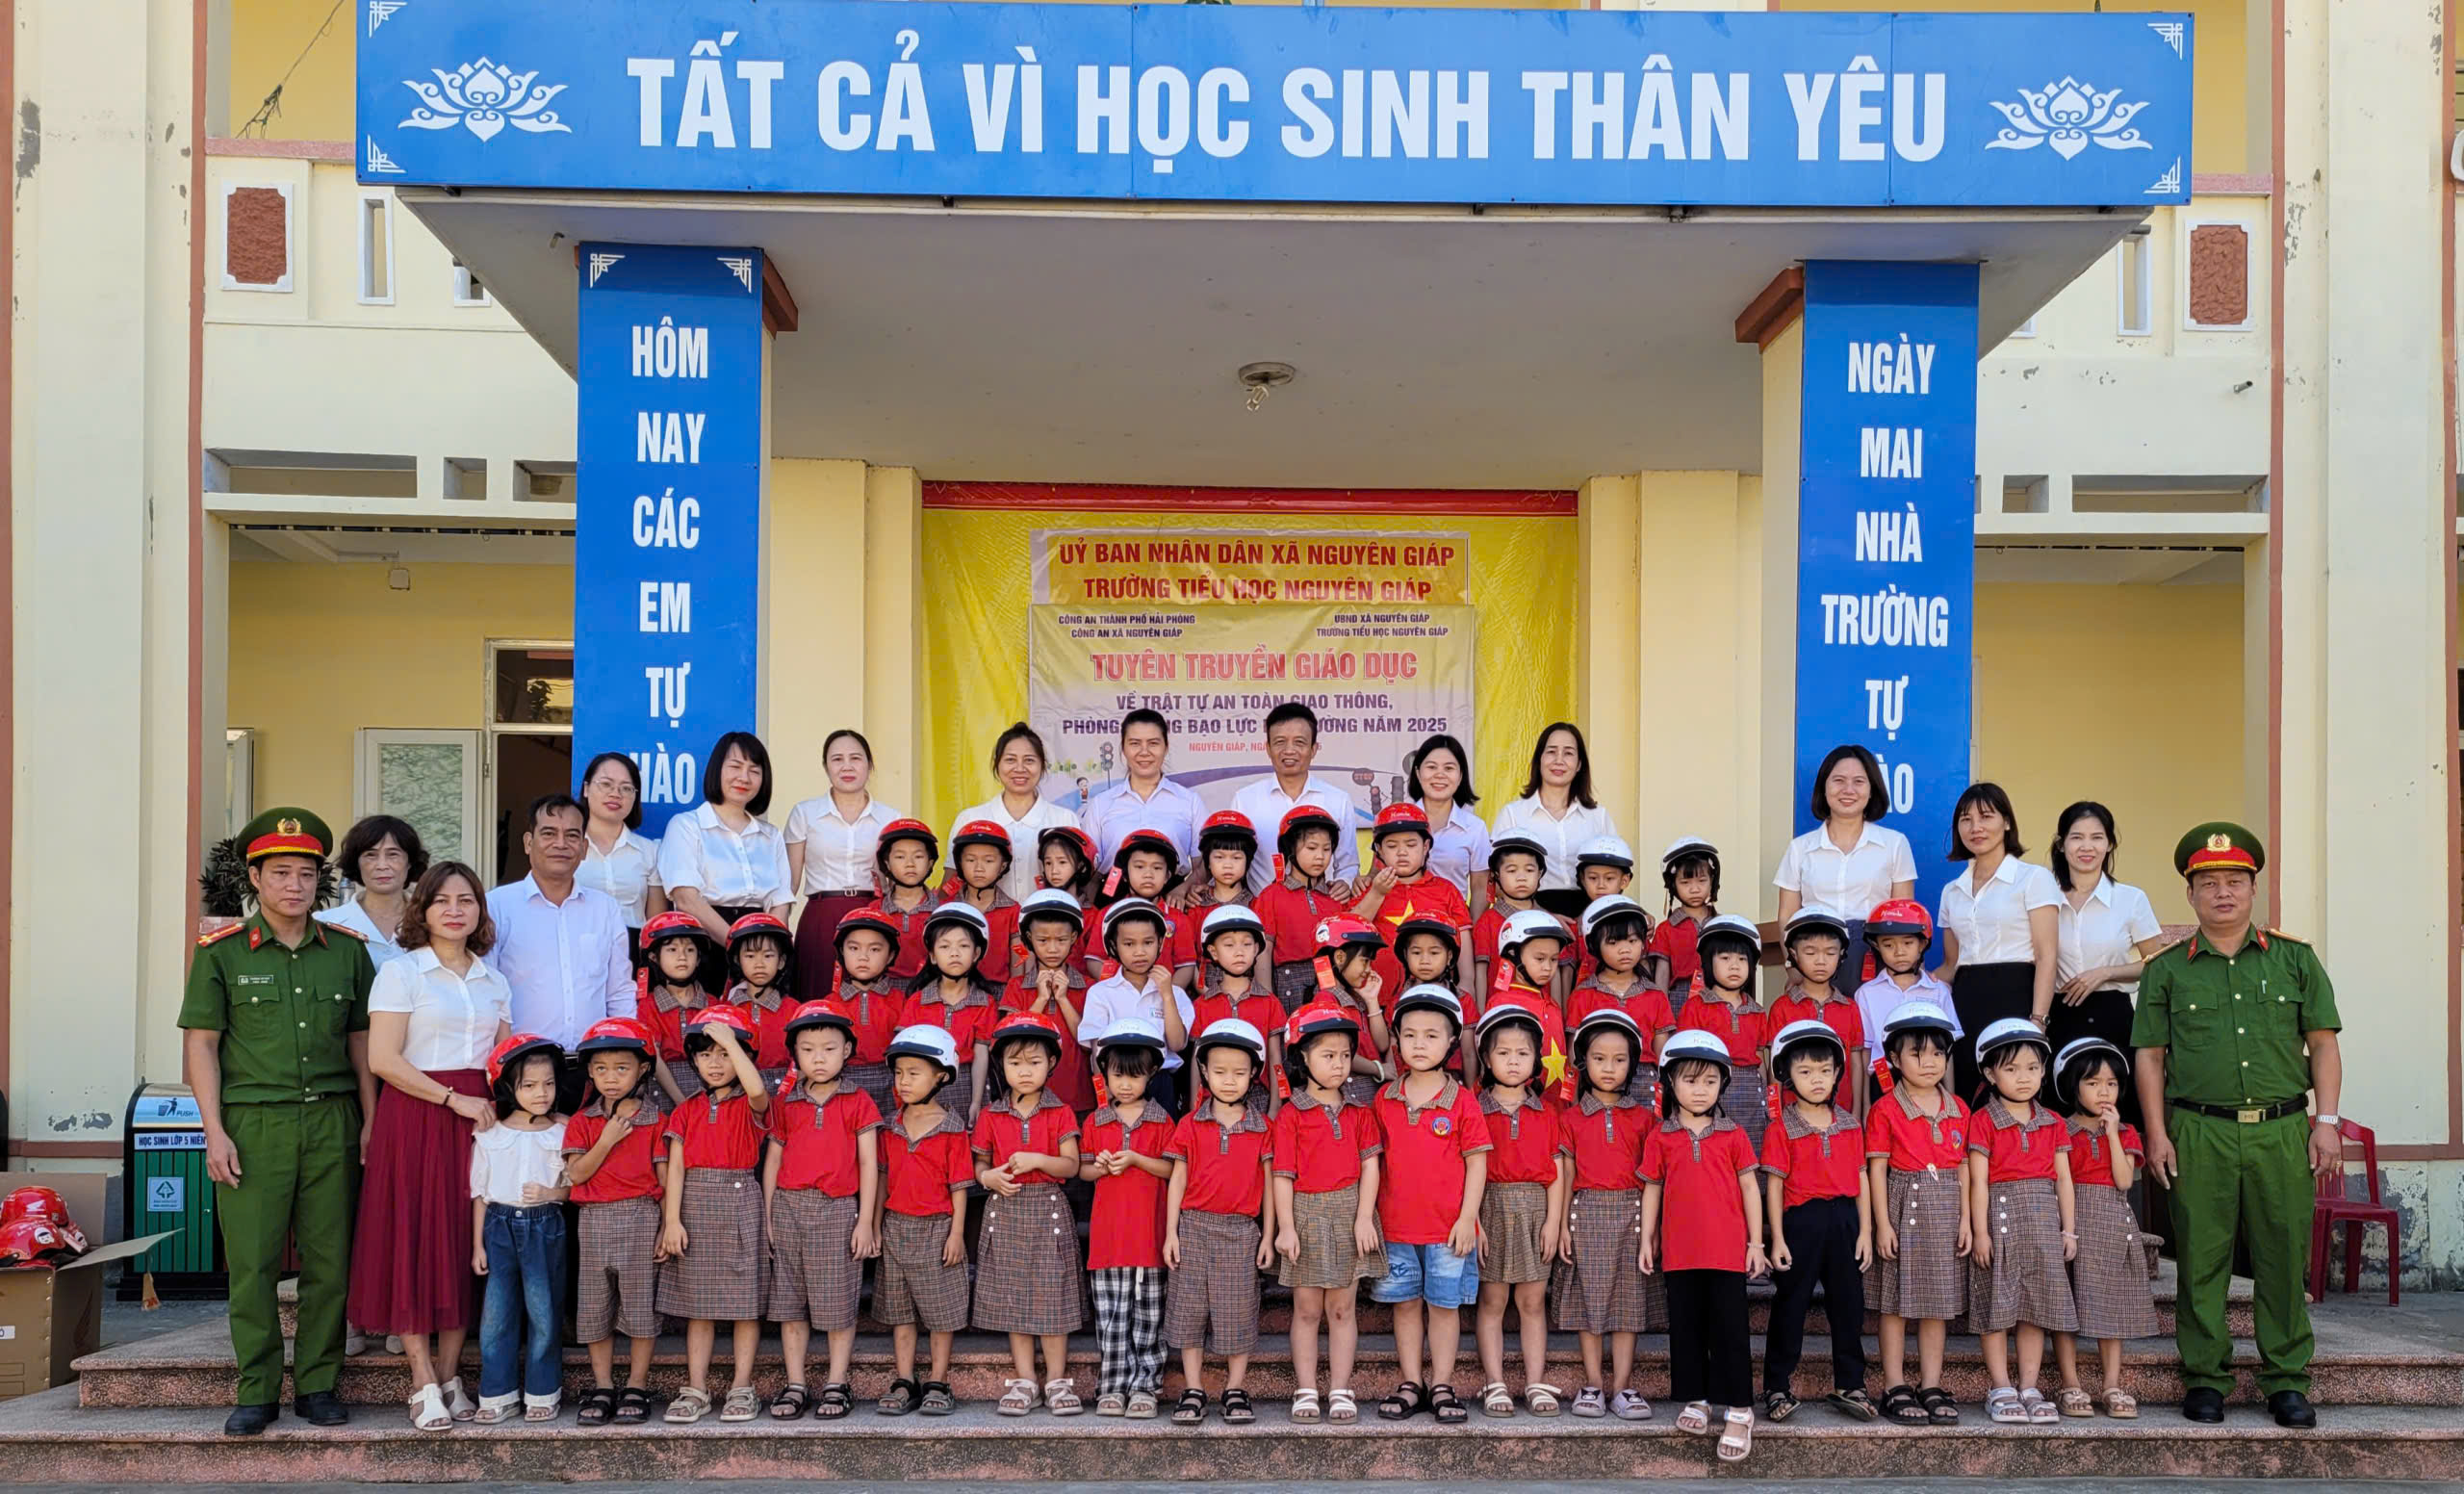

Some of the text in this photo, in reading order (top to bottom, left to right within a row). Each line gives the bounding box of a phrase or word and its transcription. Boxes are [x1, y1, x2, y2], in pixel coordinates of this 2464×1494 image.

[627, 29, 1946, 174] TẤT CẢ VÌ HỌC SINH THÂN YÊU
[631, 317, 708, 378] HÔM
[1847, 333, 1936, 394] NGÀY
[636, 412, 706, 464] NAY
[1861, 427, 1922, 478] MAI
[632, 487, 700, 549] CÁC
[1856, 502, 1923, 562] NHÀ
[1060, 537, 1454, 566] UỶ BAN NHÂN DÂN XÃ NGUYÊN GIÁP
[638, 581, 691, 633] EM
[1084, 571, 1432, 604] TRƯỜNG TIỂU HỌC NGUYÊN GIÁP
[1059, 613, 1082, 625] CÔNG
[1099, 613, 1127, 625] THÀNH
[1167, 613, 1195, 625] PHÒNG
[1071, 627, 1183, 638] CÔNG AN XÃ NGUYÊN GIÁP
[1334, 612, 1430, 624] UBND XÃ NGUYÊN GIÁP
[1373, 628, 1390, 638] HỌC
[1392, 627, 1426, 636] NGUYÊN
[1428, 626, 1449, 636] GIÁP
[1821, 584, 1949, 648] TRƯỜNG
[1091, 643, 1418, 684] TUYÊN TRUYỀN GIÁO DỤC
[645, 661, 691, 728] TỰ
[1116, 689, 1137, 710] VỀ
[1142, 692, 1182, 713] TRẬT
[1187, 693, 1210, 712] TỰ
[1213, 695, 1236, 709] AN
[1334, 690, 1394, 710] THÔNG,
[1865, 676, 1910, 740] TỰ
[1063, 715, 1119, 734] PHÒNG
[1188, 718, 1221, 736] BẠO
[1226, 717, 1257, 736] LỰC
[1363, 715, 1401, 733] NĂM
[1407, 717, 1448, 733] 2025
[1189, 741, 1223, 751] NGUYÊN
[139, 1136, 152, 1147] HỌC
[154, 1136, 169, 1146] SINH
[170, 1134, 183, 1146] LỚP
[185, 1136, 189, 1146] 5
